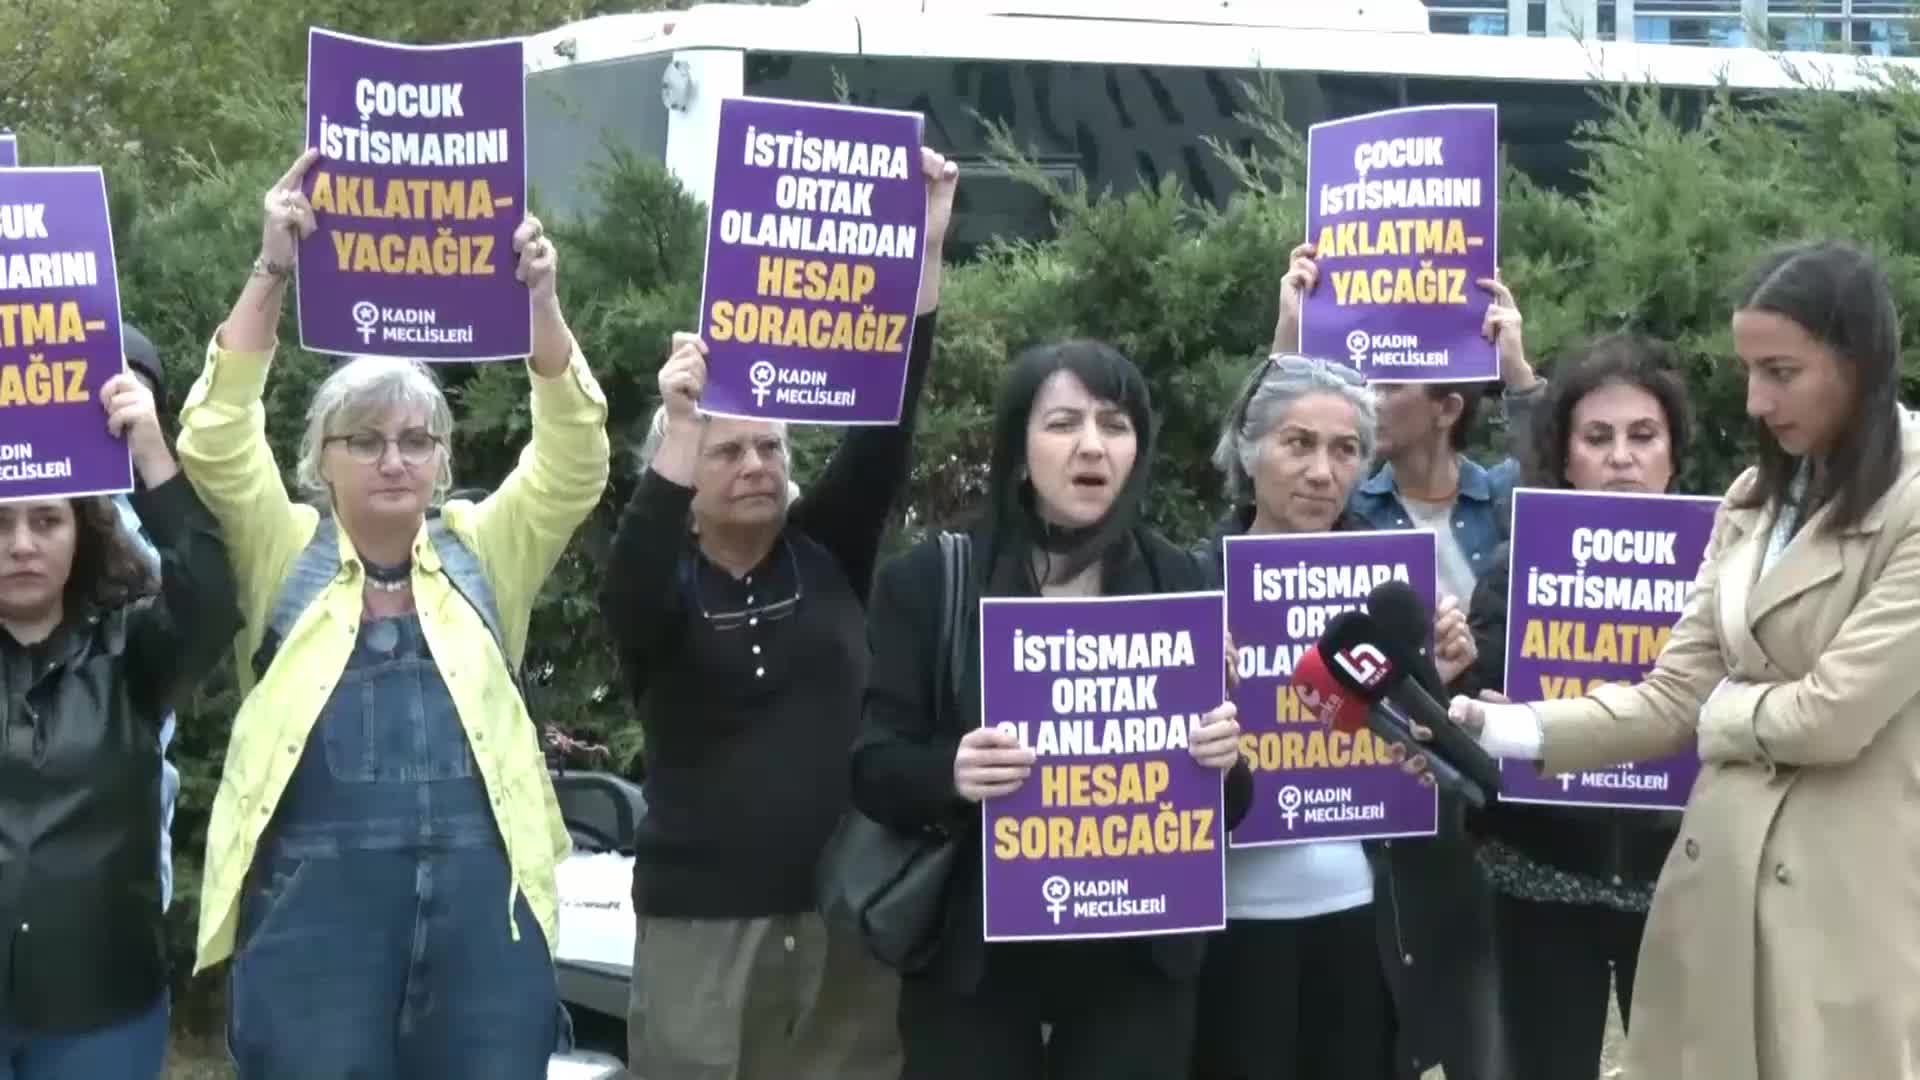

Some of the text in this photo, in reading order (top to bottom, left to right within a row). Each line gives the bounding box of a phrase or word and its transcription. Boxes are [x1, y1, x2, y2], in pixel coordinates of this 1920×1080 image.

[355, 78, 464, 120] ÇOCUK
[320, 115, 509, 166] İSTİSMARINI
[744, 125, 909, 180] İSTİSMARA
[1354, 137, 1444, 176] ÇOCUK
[311, 172, 512, 220] AKLATMA-
[775, 175, 874, 216] ORTAK
[1319, 178, 1481, 216] İSTİSMARINI
[331, 227, 495, 276] YACAĞIZ
[720, 210, 916, 259] OLANLARDAN
[1316, 218, 1484, 258] AKLATMA-
[0, 252, 97, 289] ARINI
[757, 256, 875, 304] HESAP
[1330, 261, 1468, 306] YACAĞIZ
[0, 301, 105, 347] TMA-
[382, 307, 436, 324] KADIN
[383, 324, 473, 343] MECLİSLERİ
[709, 301, 907, 353] SORACAĞIZ
[1371, 334, 1418, 349] KADIN
[1372, 349, 1448, 367] MECLİSLERİ
[776, 387, 856, 406] MECLİSLERİ
[778, 367, 827, 386] KADIN
[0, 443, 32, 460] DIN
[1571, 527, 1677, 567] ÇOCUK
[1526, 567, 1696, 612] İSTİSMARI
[1013, 628, 1195, 673] İSTİSMARA
[1520, 619, 1672, 664] AKLATM
[1052, 675, 1158, 714] ORTAK
[1238, 726, 1393, 770] SORACA
[1041, 760, 1169, 807] HESAP
[1304, 787, 1352, 804] KADIN
[1581, 770, 1669, 791] MECLİSLERİ
[994, 802, 1215, 860] SORACAĞIZ
[1304, 802, 1385, 823] MECLİSLERİ
[1074, 879, 1129, 896] KADIN
[1074, 895, 1166, 918] MECLİSLERİ
